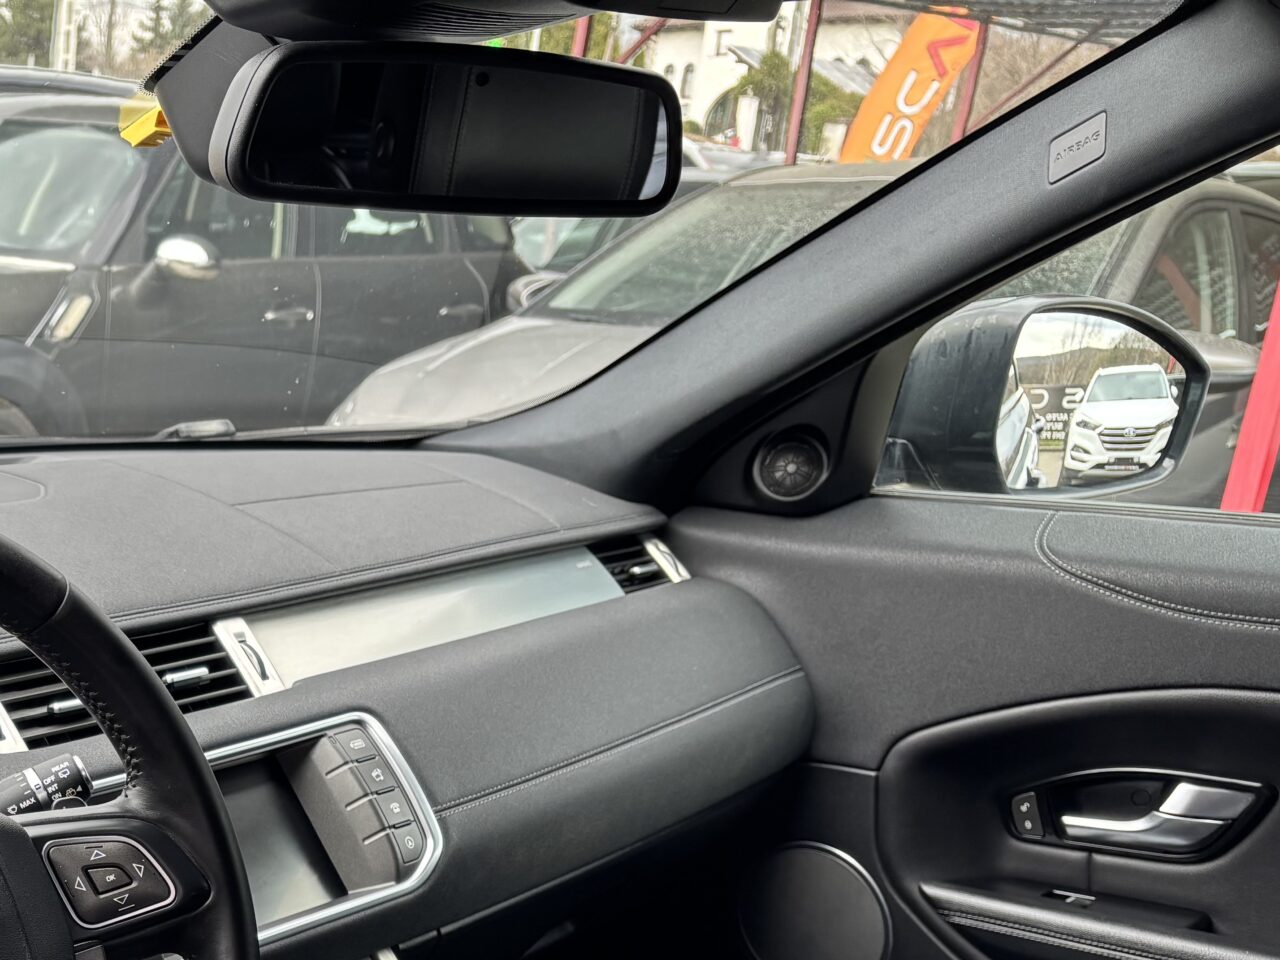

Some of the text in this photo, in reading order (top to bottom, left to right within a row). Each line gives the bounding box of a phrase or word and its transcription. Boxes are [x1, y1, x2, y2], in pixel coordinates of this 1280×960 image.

[1054, 130, 1101, 163] AIRBAG
[43, 774, 55, 786] OFF
[47, 783, 58, 794] INT
[52, 791, 62, 801] ON
[19, 797, 36, 810] MAX
[105, 873, 116, 882] OK
